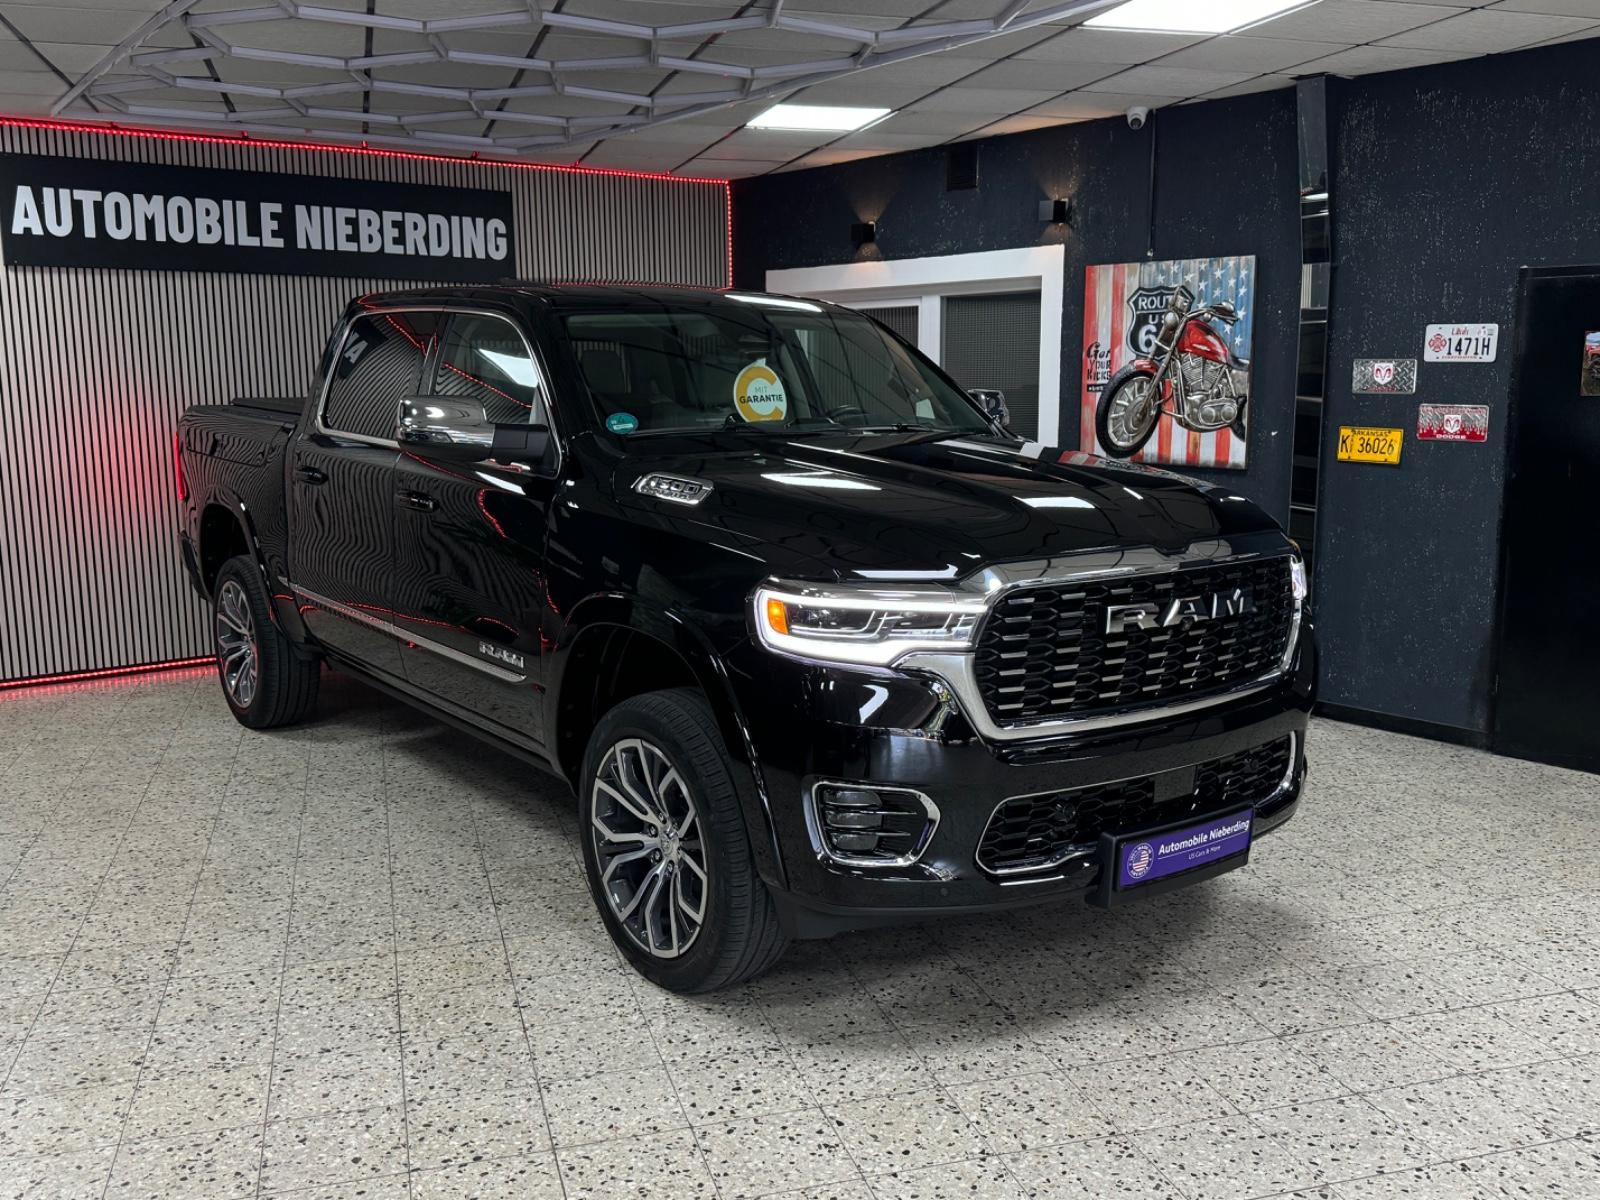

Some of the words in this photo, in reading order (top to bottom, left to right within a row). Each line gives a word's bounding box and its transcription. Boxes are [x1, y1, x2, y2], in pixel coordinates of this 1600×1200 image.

[11, 185, 284, 248] AUTOMOBILE
[295, 204, 508, 260] NIEBERDING
[1138, 295, 1174, 310] ROUT
[1447, 337, 1491, 356] 1471H
[739, 394, 784, 404] GARANTIE
[1352, 429, 1390, 437] ARKANSAS
[1357, 436, 1394, 456] 36026
[1106, 589, 1253, 634] RAM
[1158, 833, 1208, 855] Automobile
[1209, 819, 1250, 841] Nieberding
